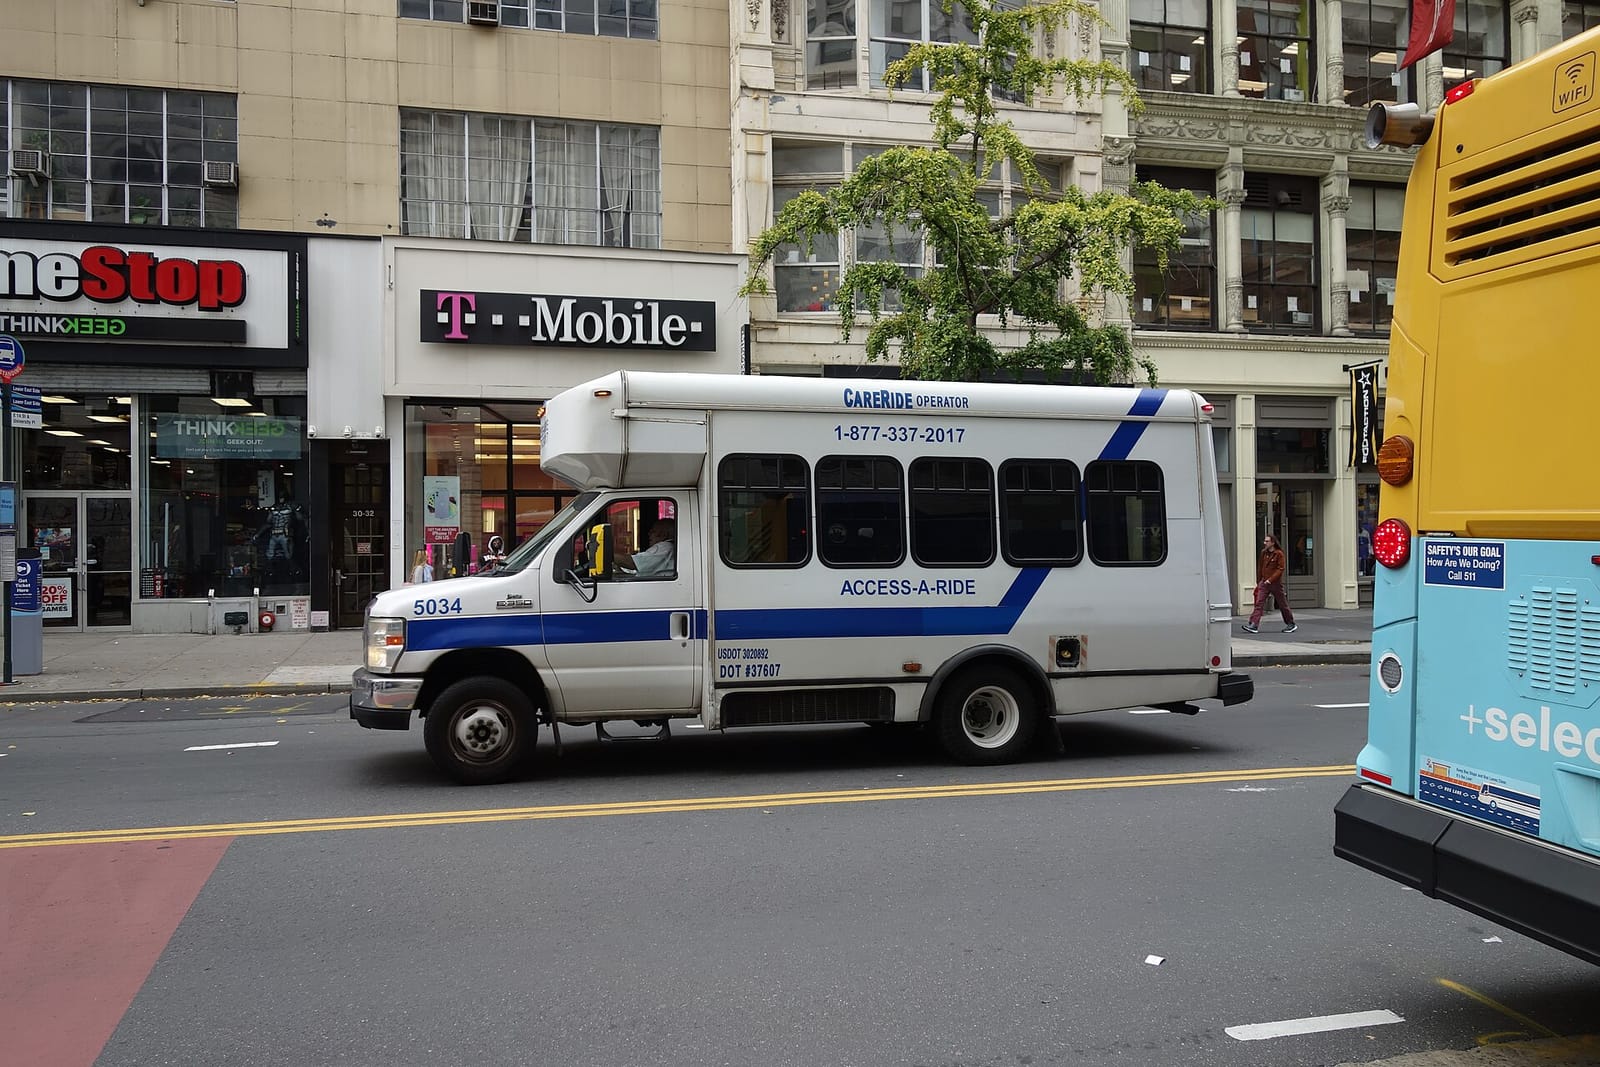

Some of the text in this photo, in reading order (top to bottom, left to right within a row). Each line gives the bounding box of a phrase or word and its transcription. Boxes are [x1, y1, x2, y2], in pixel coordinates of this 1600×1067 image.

[1559, 84, 1587, 106] WIFI
[916, 395, 969, 408] OPERATOR
[834, 425, 966, 442] 1-877-337-2017
[1427, 544, 1502, 557] SAFETY'S OUR GOAL
[1426, 558, 1501, 571] How Are We Doing?
[1448, 570, 1476, 581] Call 511
[42, 585, 67, 594] 20%
[840, 580, 976, 596] ACCESS-A-RIDE
[42, 595, 67, 603] OFF
[414, 598, 462, 615] 5034
[718, 648, 741, 659] USDOT
[720, 664, 780, 678] DOT #37607
